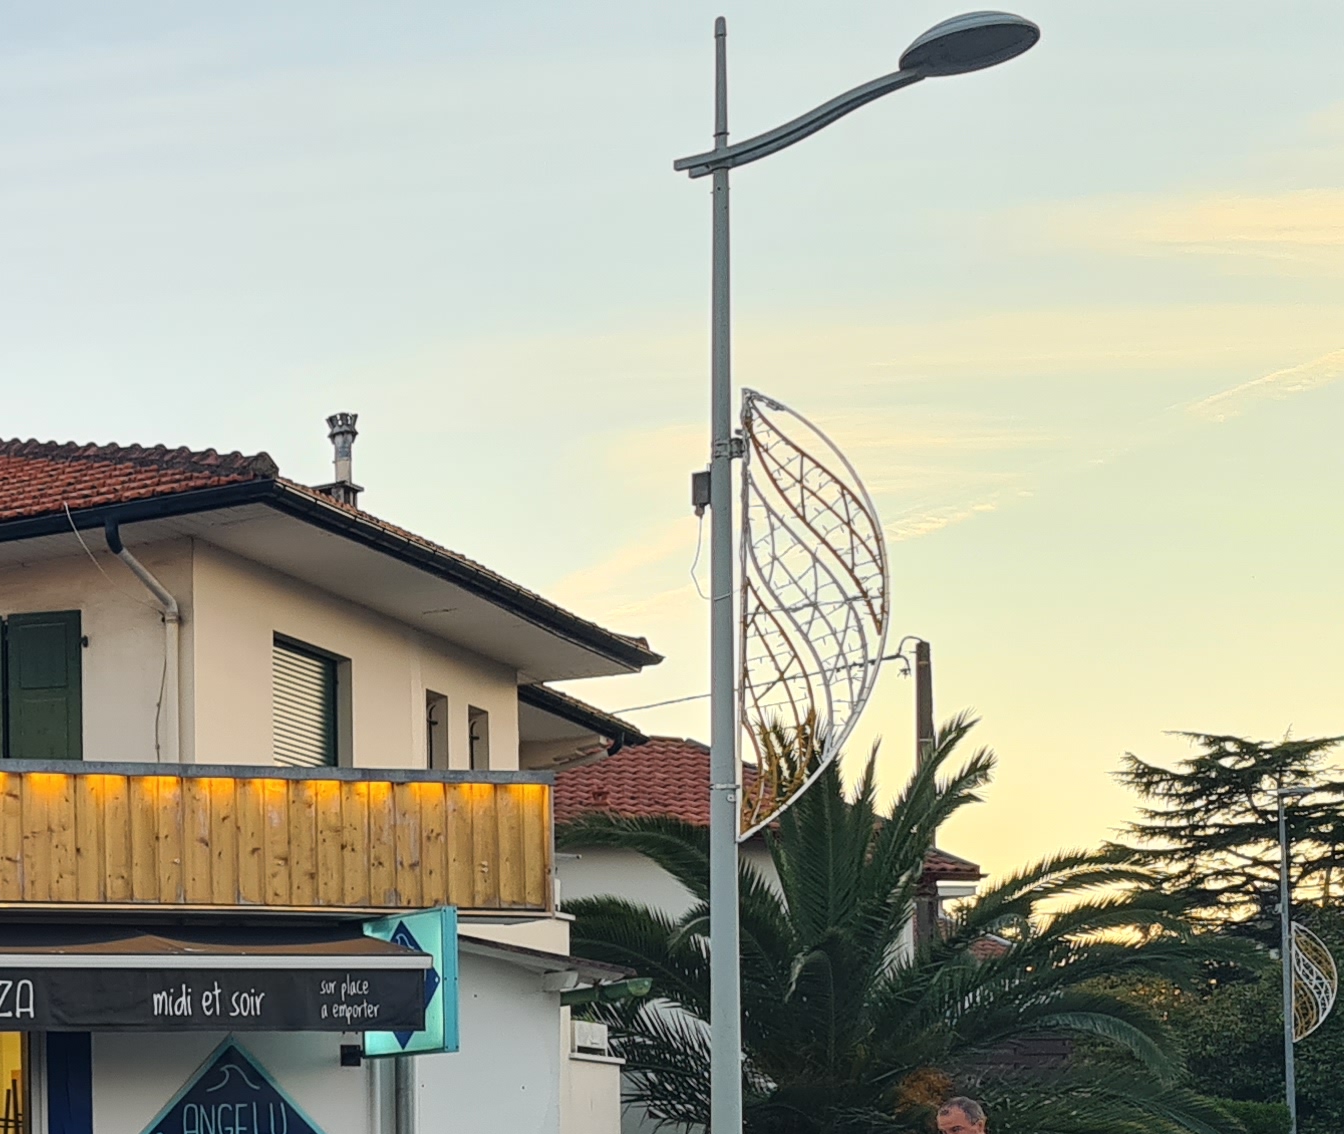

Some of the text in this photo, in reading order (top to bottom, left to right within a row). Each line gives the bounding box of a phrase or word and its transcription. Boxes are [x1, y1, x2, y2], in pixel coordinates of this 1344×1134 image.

[152, 980, 266, 1017] midi et soir
[320, 974, 369, 1001] sur place
[332, 999, 380, 1025] emporter
